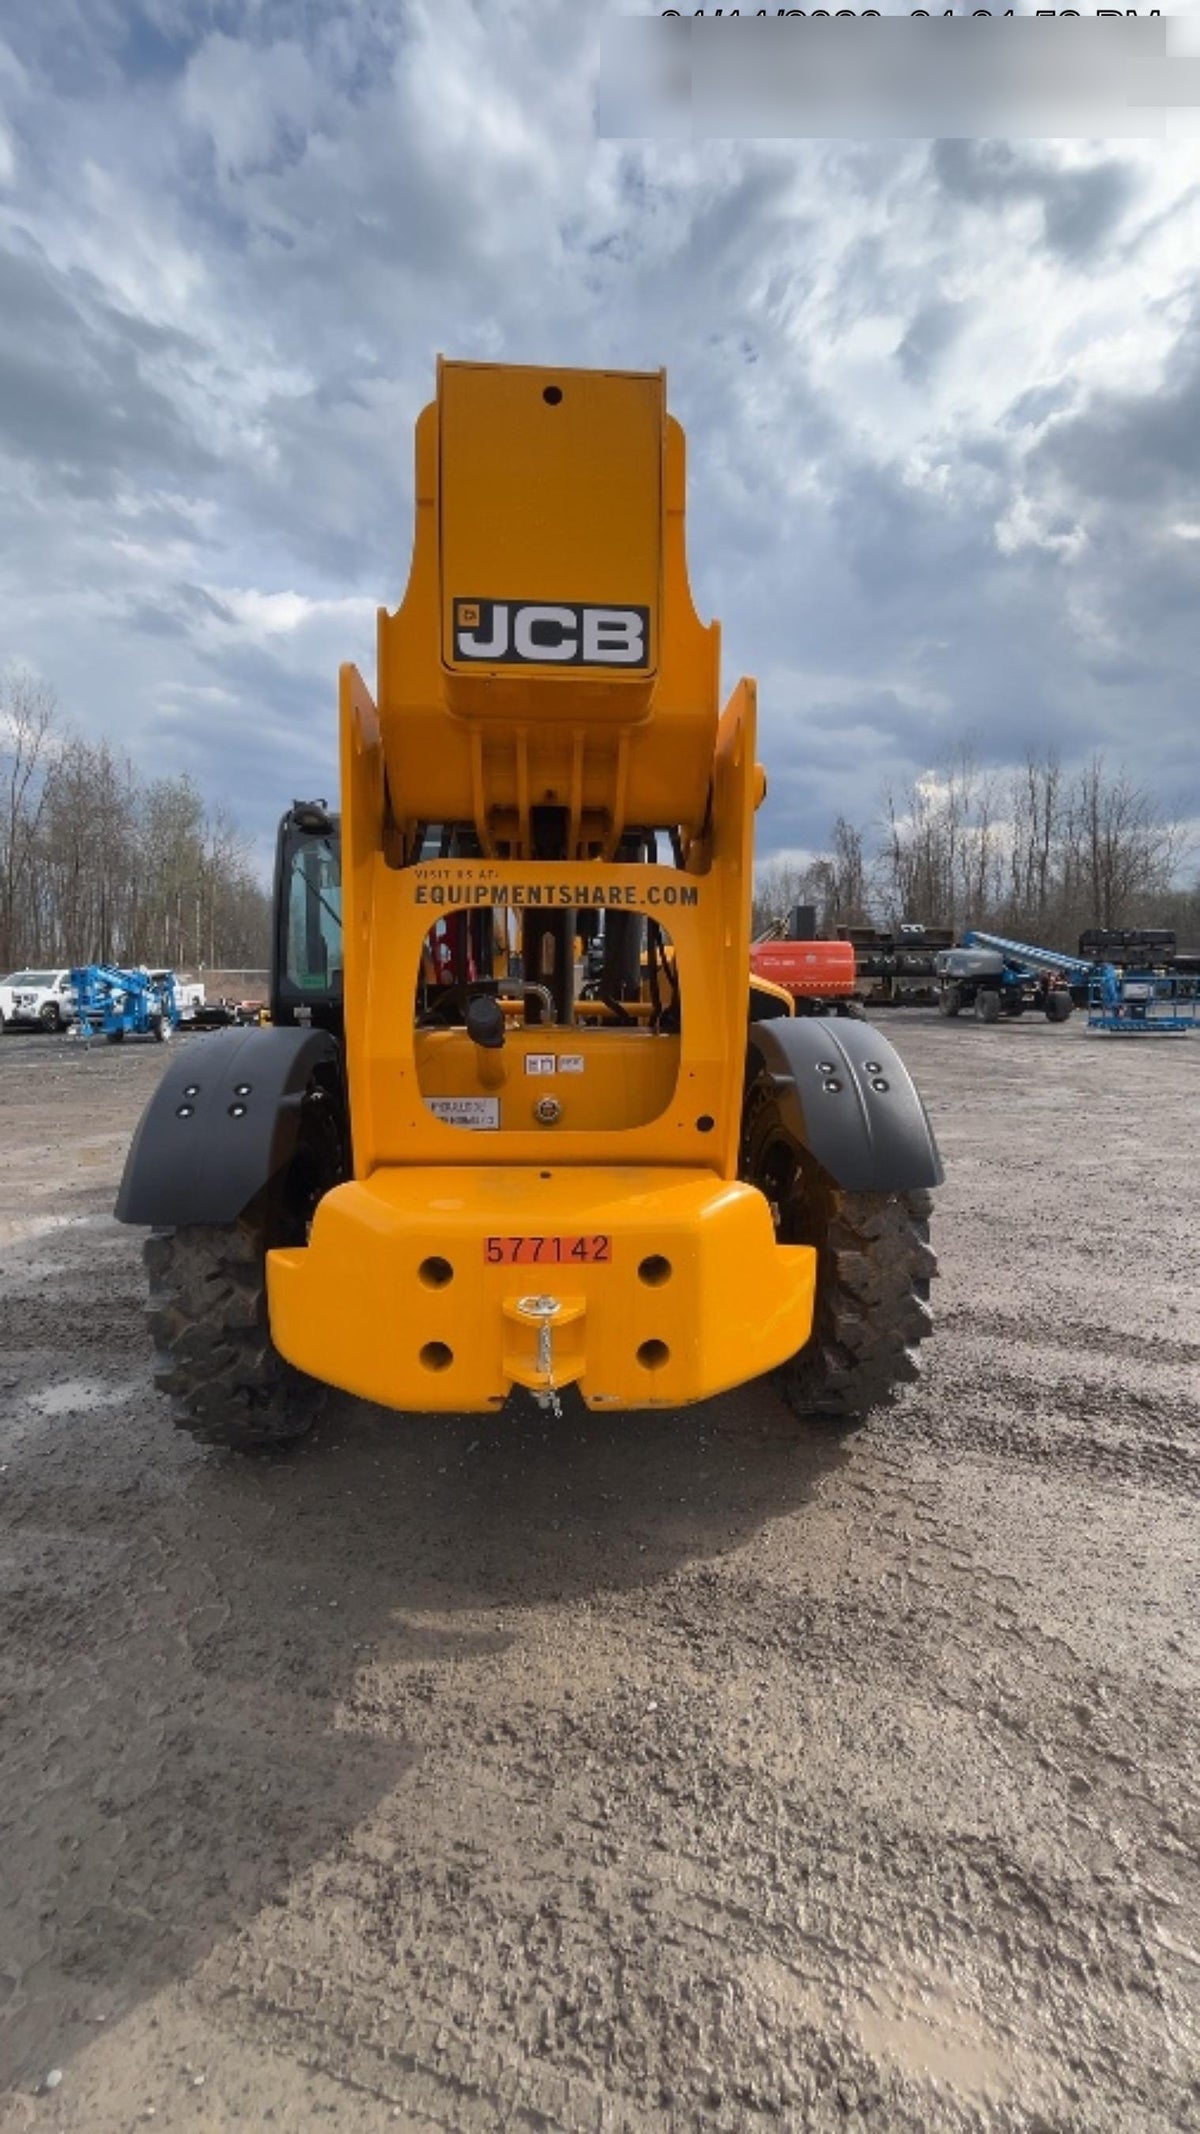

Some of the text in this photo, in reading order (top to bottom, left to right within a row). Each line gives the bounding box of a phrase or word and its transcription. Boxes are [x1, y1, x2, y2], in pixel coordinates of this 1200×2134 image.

[457, 604, 644, 662] JCB
[415, 886, 699, 906] EQUIPMENTSHARE.COM
[487, 1235, 608, 1262] 577142
